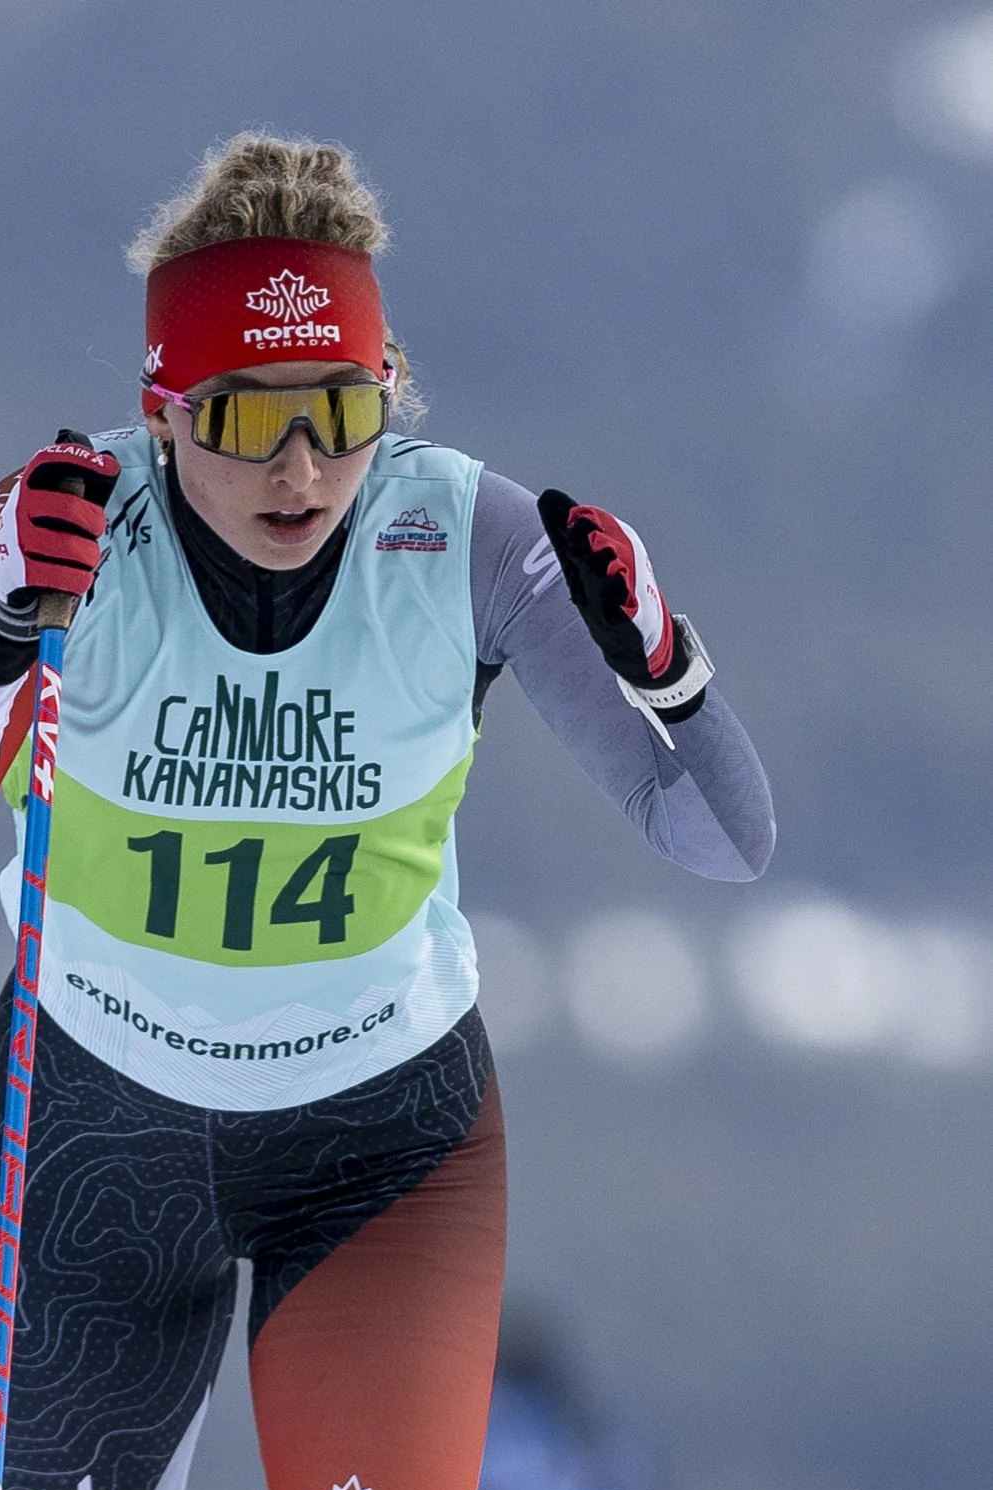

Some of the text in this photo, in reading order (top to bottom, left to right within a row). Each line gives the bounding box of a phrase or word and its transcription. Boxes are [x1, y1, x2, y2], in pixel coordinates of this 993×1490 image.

[243, 321, 341, 344] nordiq
[256, 338, 331, 350] CANADA
[122, 750, 382, 812] KANANASKIS
[127, 829, 360, 951] 114
[65, 970, 396, 1061] explorecanmore.ca
